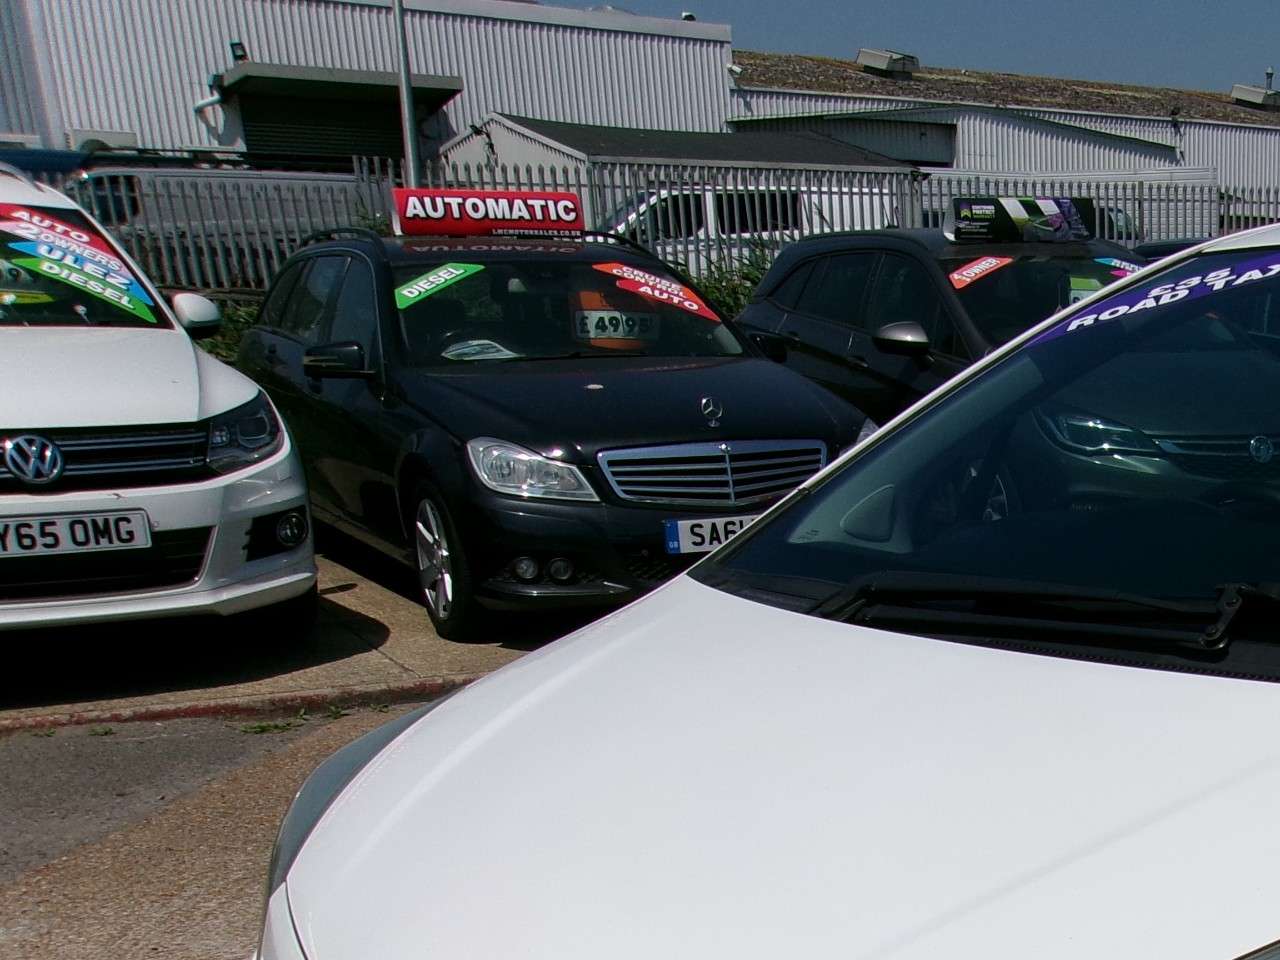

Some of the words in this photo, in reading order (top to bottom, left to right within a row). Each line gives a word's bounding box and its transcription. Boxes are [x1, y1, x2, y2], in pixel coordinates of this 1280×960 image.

[406, 196, 577, 222] AUTOMATIC
[11, 211, 90, 242] AUTO
[14, 221, 40, 240] 2
[39, 234, 122, 271] OWNERS
[37, 244, 132, 291] ULEZ
[402, 267, 464, 298] DIESEL
[622, 265, 682, 291] CRUISE
[962, 257, 1001, 277] OWNER
[1147, 267, 1232, 298] £35
[40, 260, 135, 309] DIESEL
[612, 268, 688, 299] CONTROL
[637, 285, 699, 311] AUTO
[1066, 289, 1191, 332] ROAD
[69, 516, 135, 547] OMG
